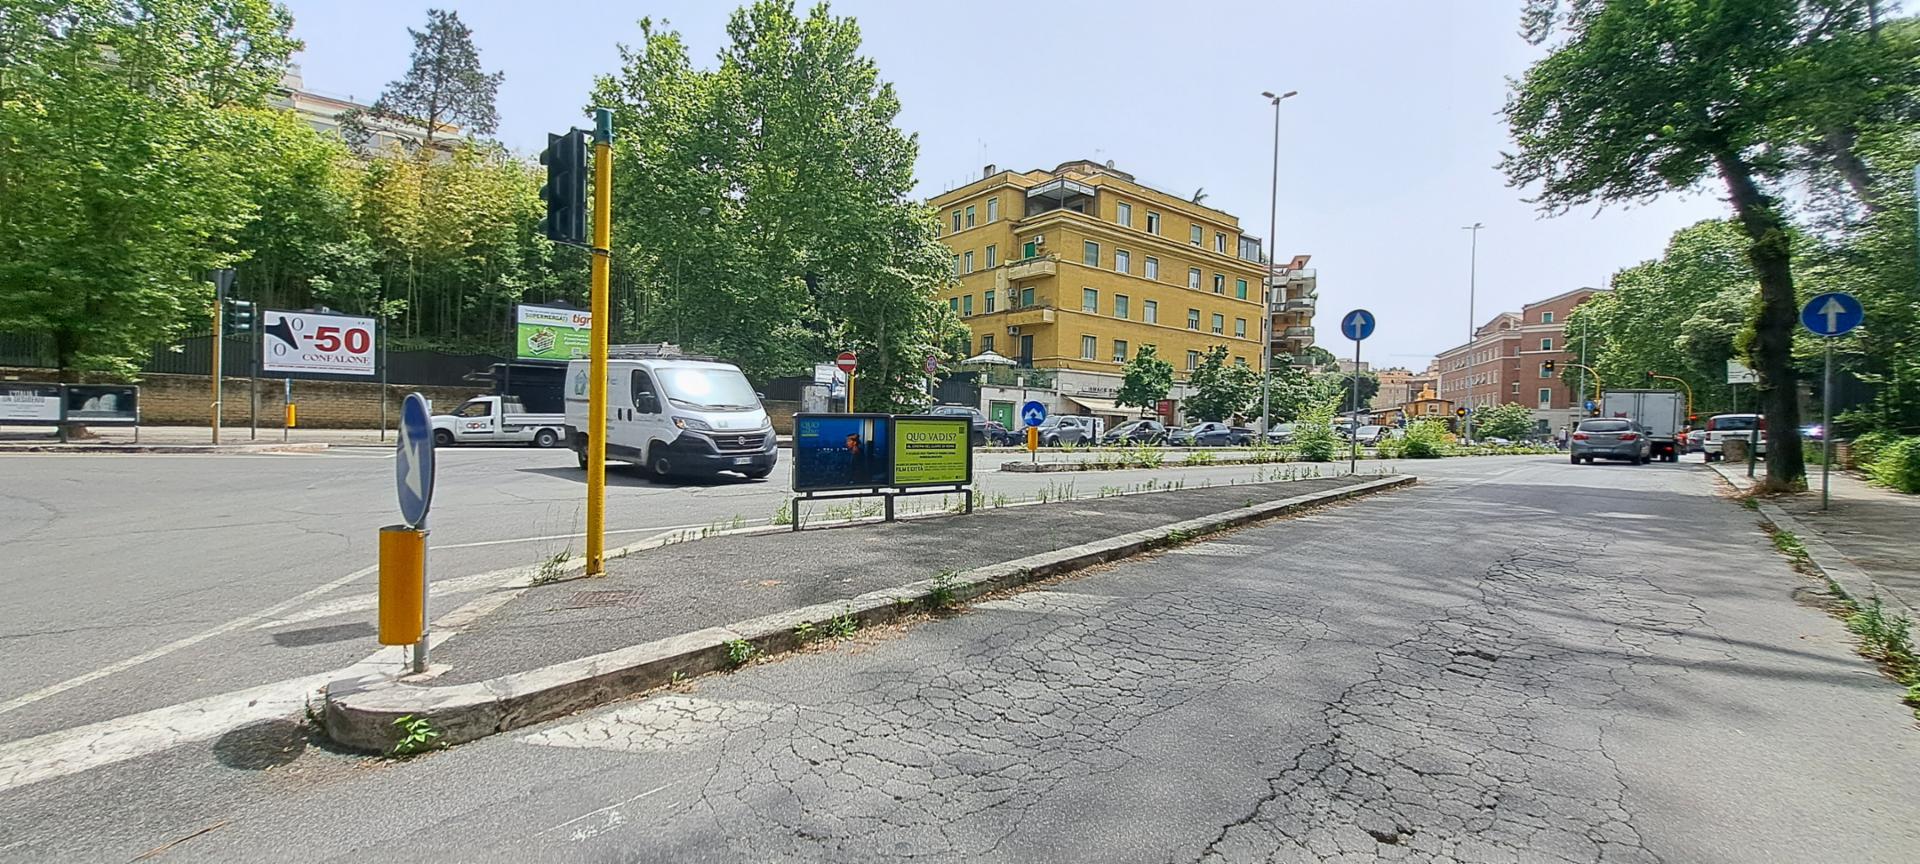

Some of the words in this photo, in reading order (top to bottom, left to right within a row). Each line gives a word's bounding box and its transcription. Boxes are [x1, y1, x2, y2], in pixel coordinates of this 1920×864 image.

[572, 314, 592, 326] tigr
[302, 353, 369, 364] CONFALONE
[906, 433, 926, 442] QUO
[928, 433, 957, 441] VADIS?
